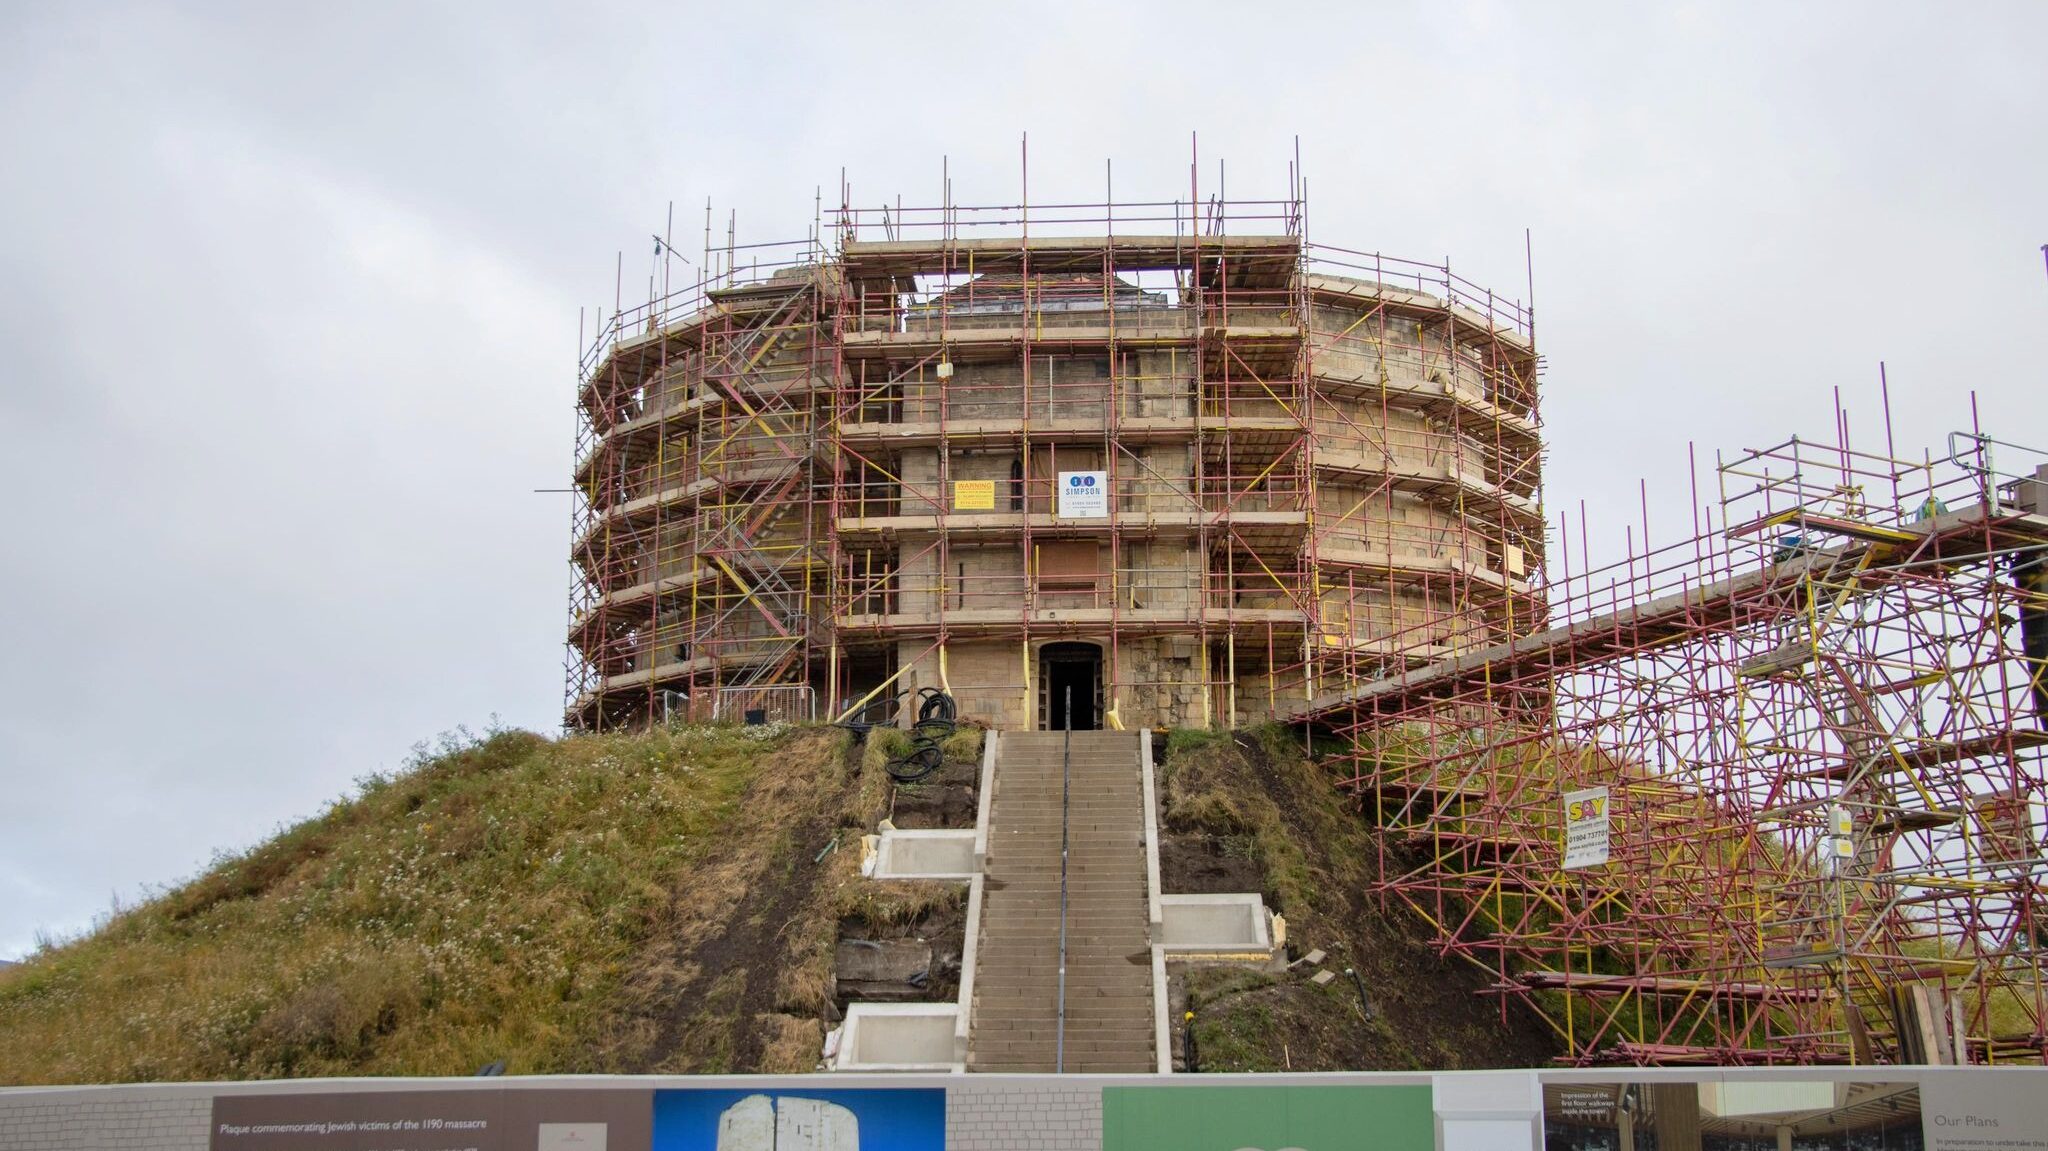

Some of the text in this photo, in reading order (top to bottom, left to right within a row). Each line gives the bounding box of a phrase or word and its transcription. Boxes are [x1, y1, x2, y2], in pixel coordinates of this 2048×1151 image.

[220, 1118, 487, 1136] Plaque commemorating Jewish victims of the 1190 massacre
[1934, 1115, 2000, 1128] Our Plans
